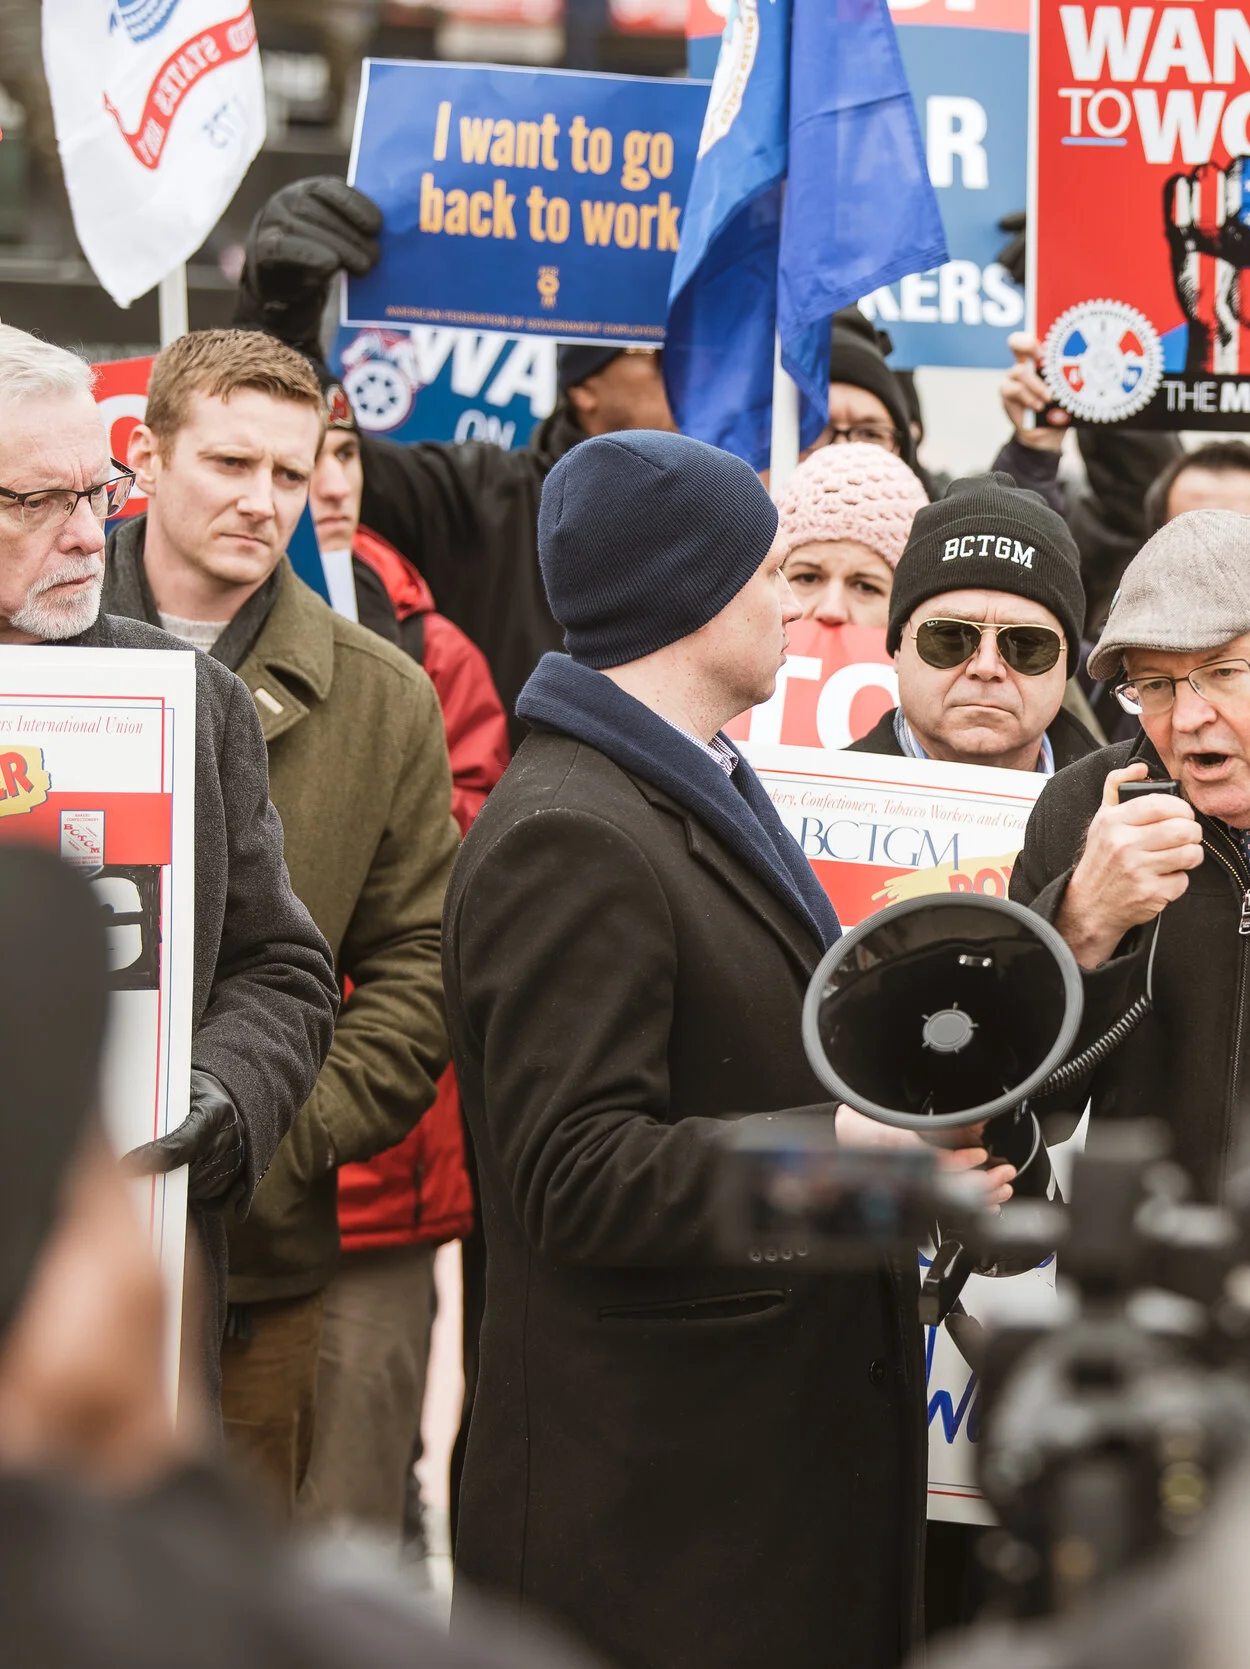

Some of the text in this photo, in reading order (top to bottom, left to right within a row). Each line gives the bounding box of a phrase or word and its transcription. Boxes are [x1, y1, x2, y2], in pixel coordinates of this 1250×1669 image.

[1058, 87, 1132, 138] TO
[433, 101, 673, 191] I want to go
[419, 172, 680, 252] back to work
[1162, 380, 1218, 412] THE
[942, 534, 1035, 569] BCTGM
[17, 714, 102, 734] International
[105, 716, 143, 735] Union
[800, 791, 878, 817] Confectionery,
[883, 799, 926, 818] Tobacco
[930, 804, 974, 824] Workers
[977, 813, 1000, 827] and
[800, 817, 959, 871] BCTGM
